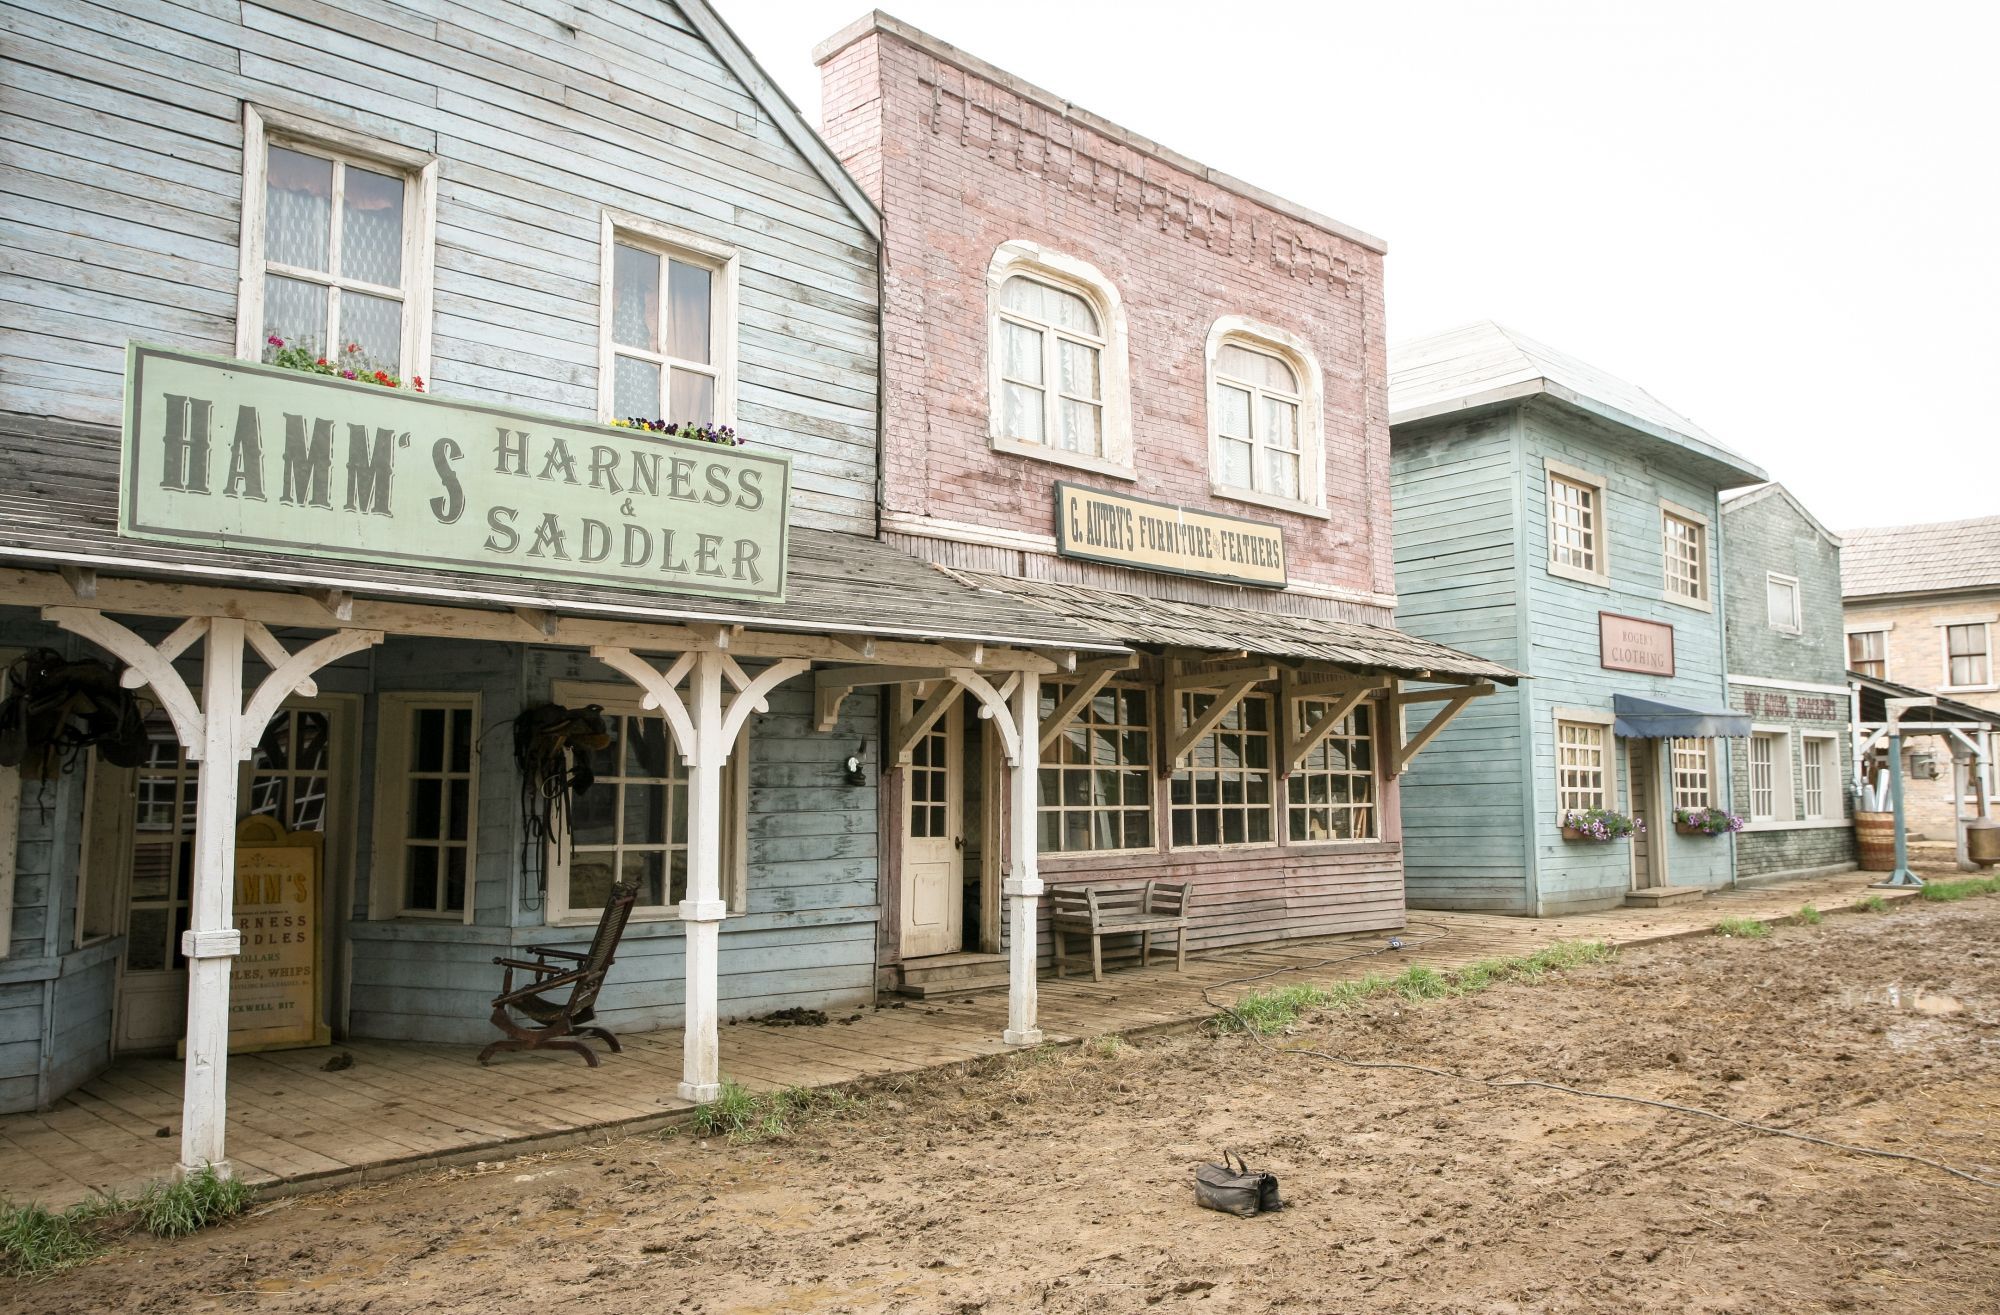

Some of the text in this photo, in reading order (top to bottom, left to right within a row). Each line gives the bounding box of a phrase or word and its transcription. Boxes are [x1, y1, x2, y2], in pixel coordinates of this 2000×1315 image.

[160, 391, 466, 525] HAMM'S
[492, 426, 766, 513] HARNESS
[619, 496, 637, 518] &
[483, 505, 763, 585] SADDLER
[1070, 496, 1083, 543] G.
[1086, 500, 1134, 552] AUTRY'S
[1138, 515, 1213, 559] FURNITURE
[1220, 530, 1280, 569] FEATHERS
[1611, 647, 1664, 668] CLOTHING
[233, 872, 308, 906] MM'S
[239, 915, 307, 930] RNESS
[240, 931, 306, 946] DDLES
[268, 966, 312, 978] WHIPS
